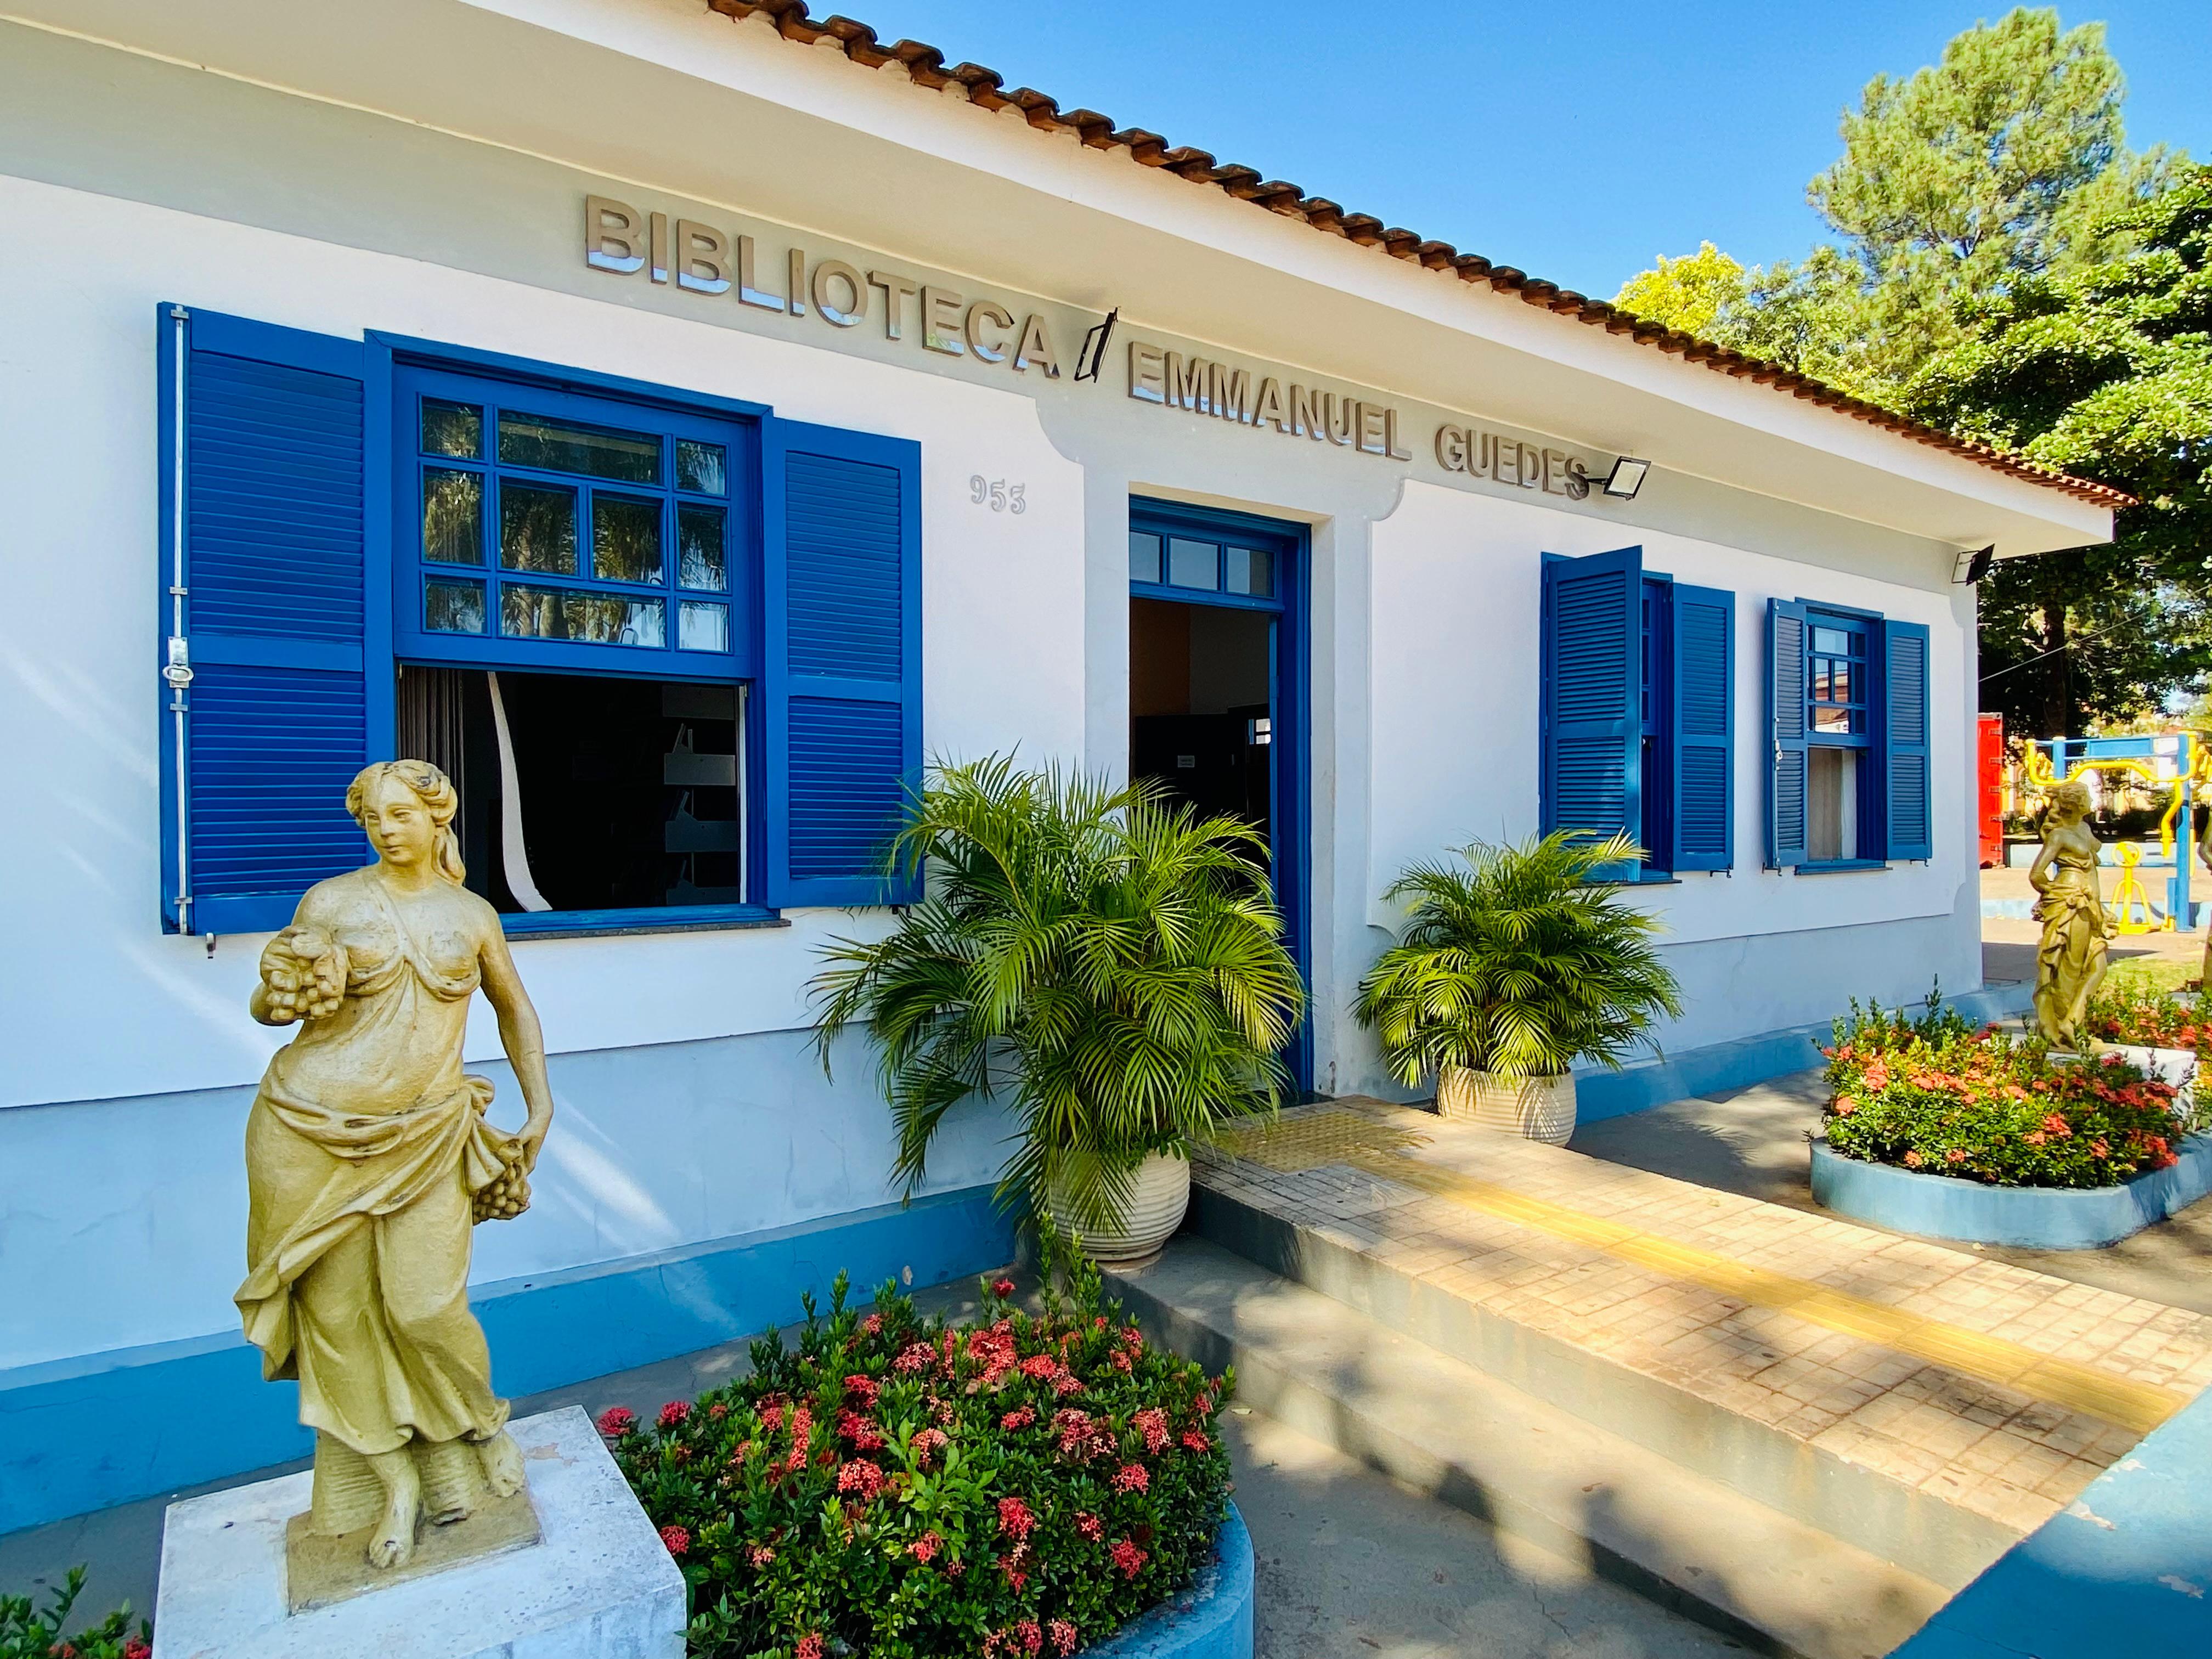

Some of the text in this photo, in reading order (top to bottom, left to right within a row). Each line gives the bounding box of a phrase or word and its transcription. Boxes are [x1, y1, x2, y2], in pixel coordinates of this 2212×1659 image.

[586, 194, 1589, 500] BIBLIOTECA EMMANUEL GUEDES
[970, 475, 1025, 515] 953
